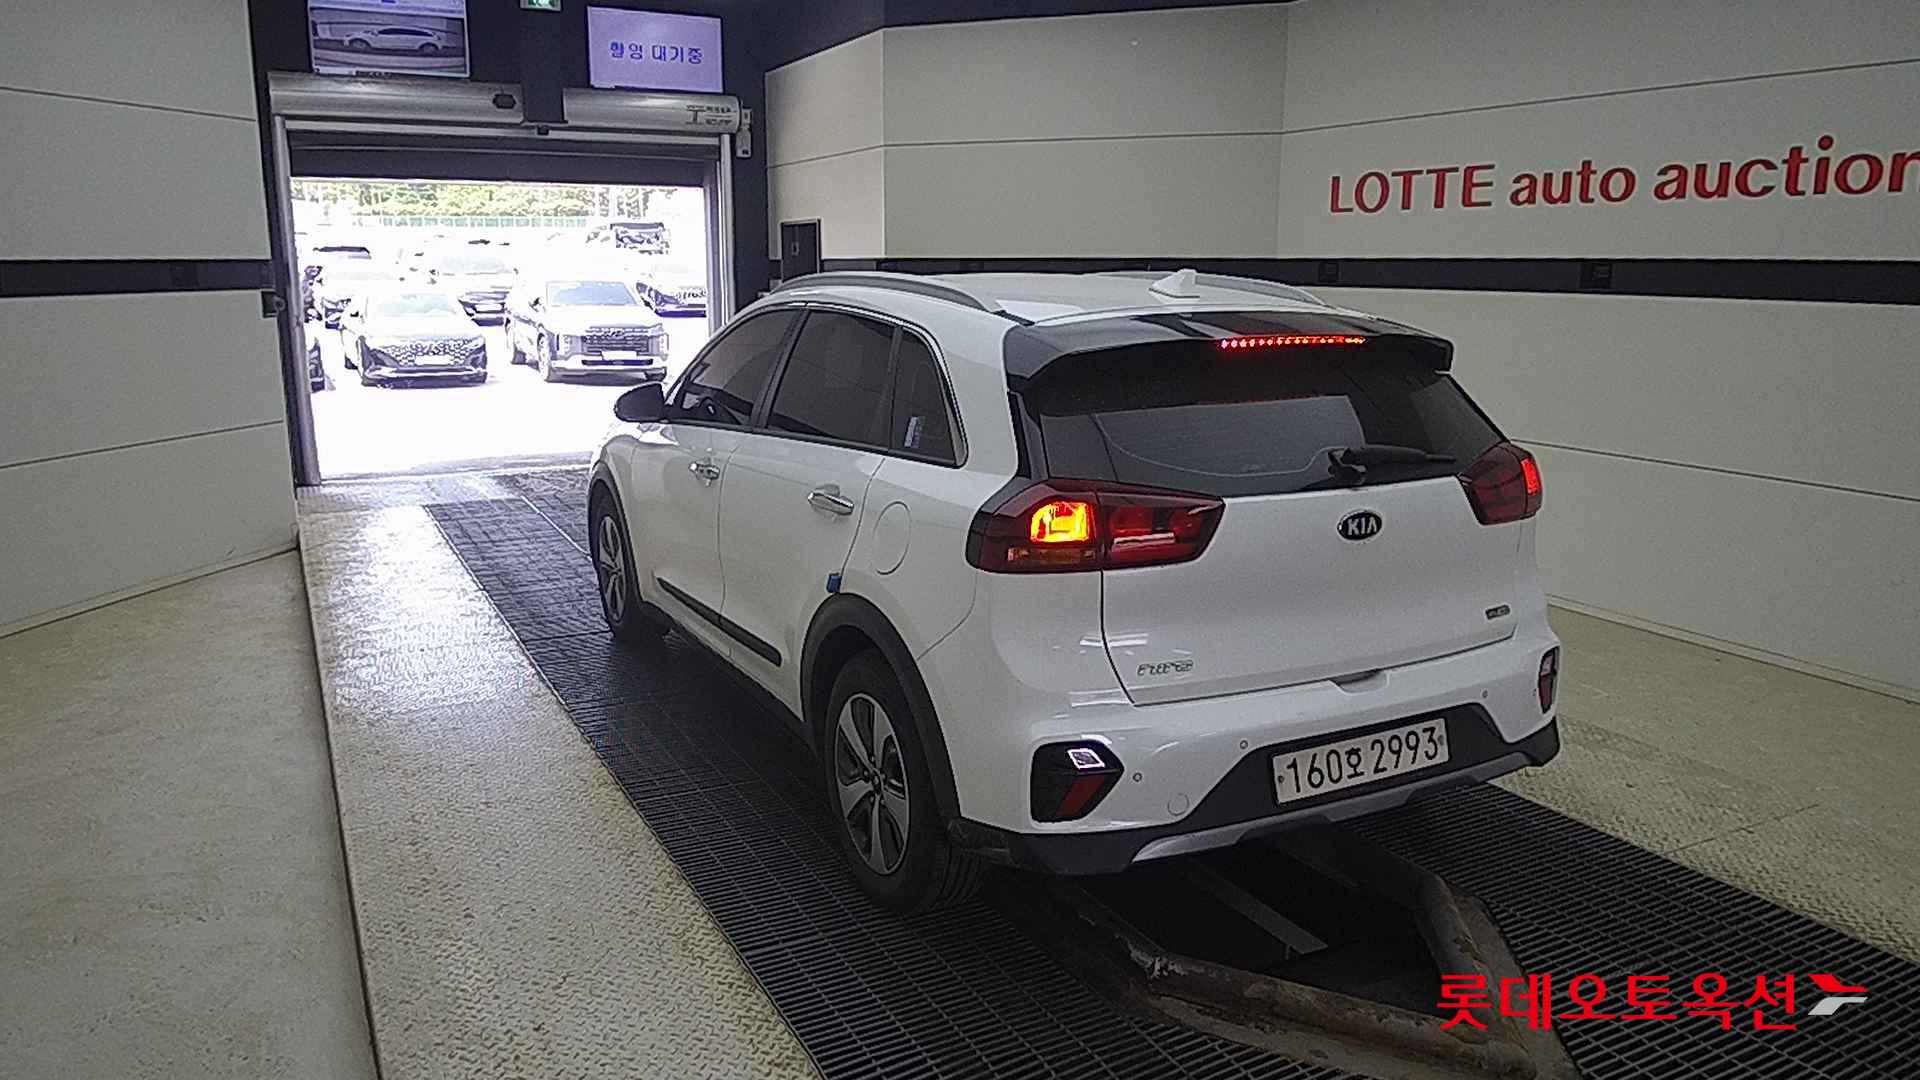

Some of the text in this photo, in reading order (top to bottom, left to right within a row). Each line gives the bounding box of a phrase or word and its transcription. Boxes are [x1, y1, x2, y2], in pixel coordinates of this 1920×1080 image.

[651, 44, 703, 65] 대기중
[1330, 163, 1495, 214] LOTTE
[1510, 159, 1637, 206] auto
[1347, 516, 1378, 536] KIA
[1370, 726, 1439, 774] 2993
